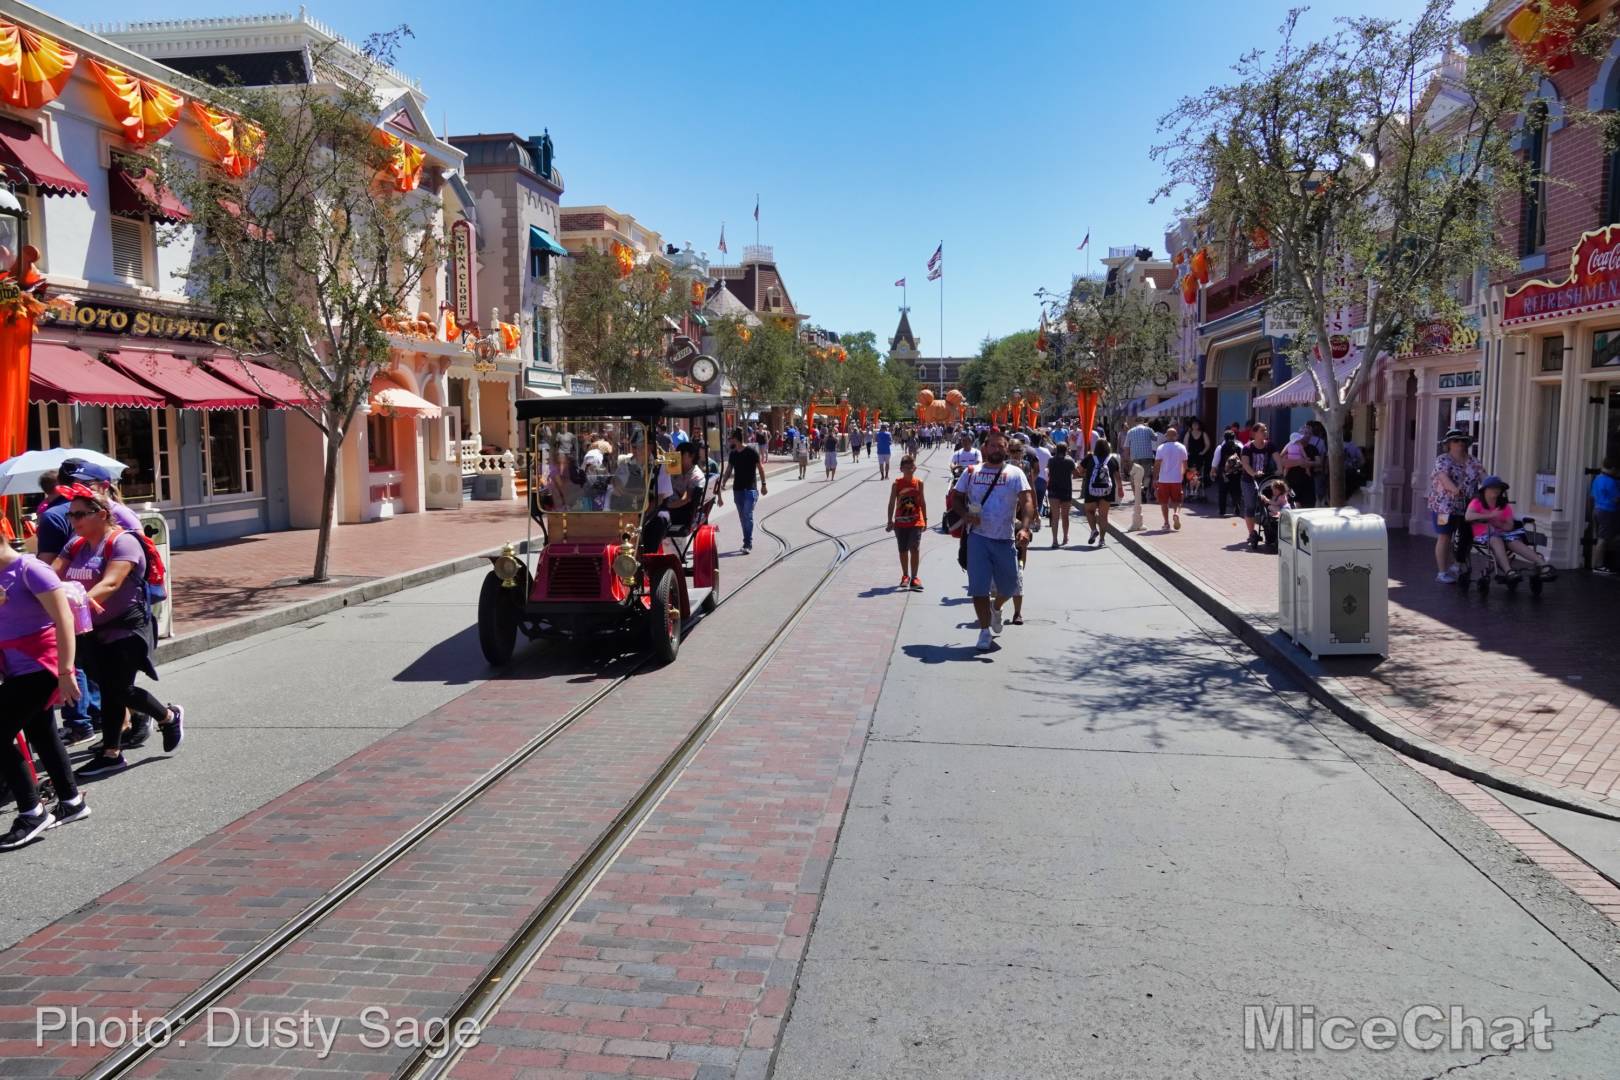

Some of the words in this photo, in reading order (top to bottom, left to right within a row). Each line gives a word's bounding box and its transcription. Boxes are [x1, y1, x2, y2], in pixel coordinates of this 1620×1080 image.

[457, 235, 467, 270] CHINA
[1587, 242, 1620, 275] Coca-Co
[458, 274, 467, 316] CLOSET
[1524, 280, 1620, 314] REFRESHMEN
[46, 304, 129, 330] HOTO
